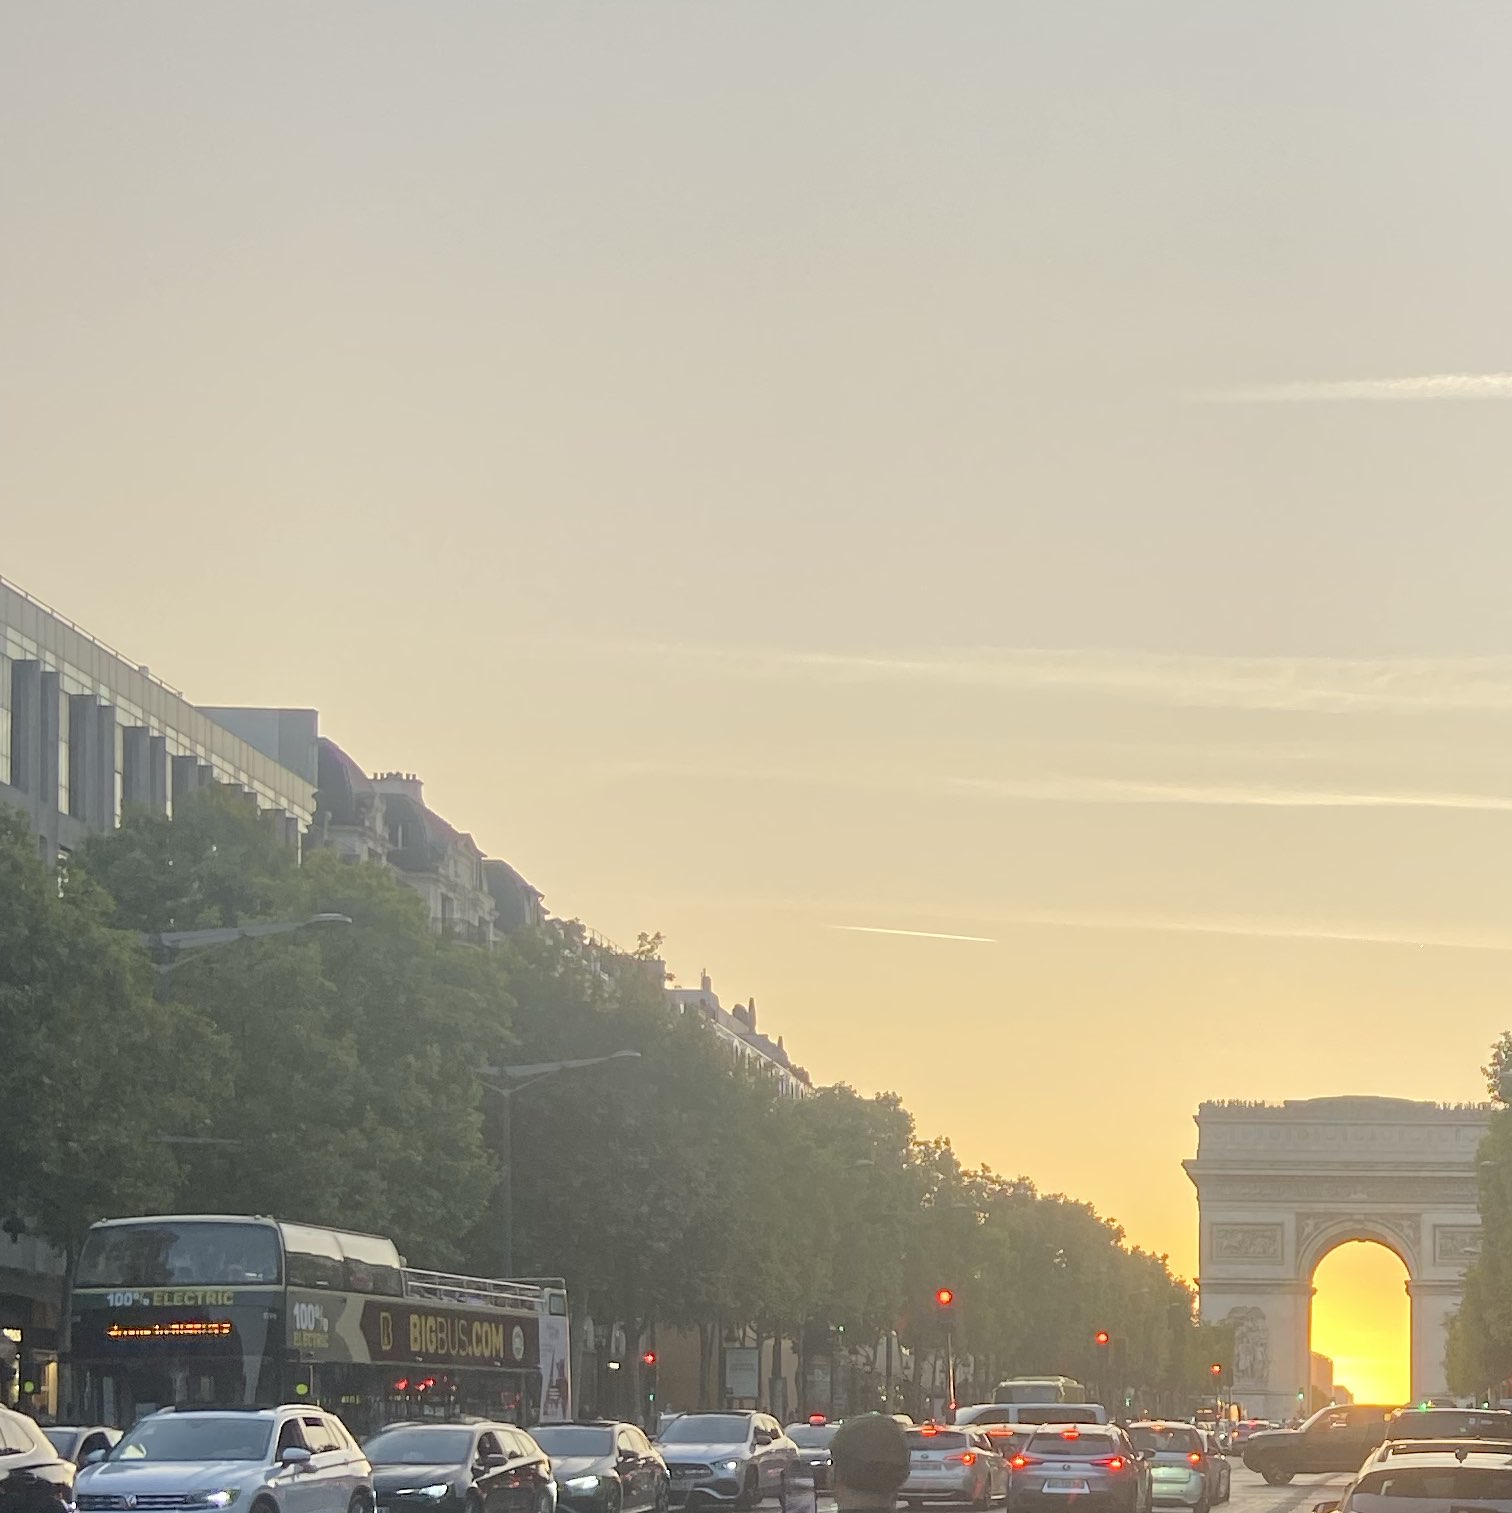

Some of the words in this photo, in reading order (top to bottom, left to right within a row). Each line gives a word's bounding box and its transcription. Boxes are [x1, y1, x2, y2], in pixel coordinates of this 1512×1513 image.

[107, 1291, 150, 1306] 100%
[153, 1290, 235, 1305] ELECTRIC
[293, 1301, 329, 1332] 100%
[410, 1314, 504, 1359] BIGBUS.COM
